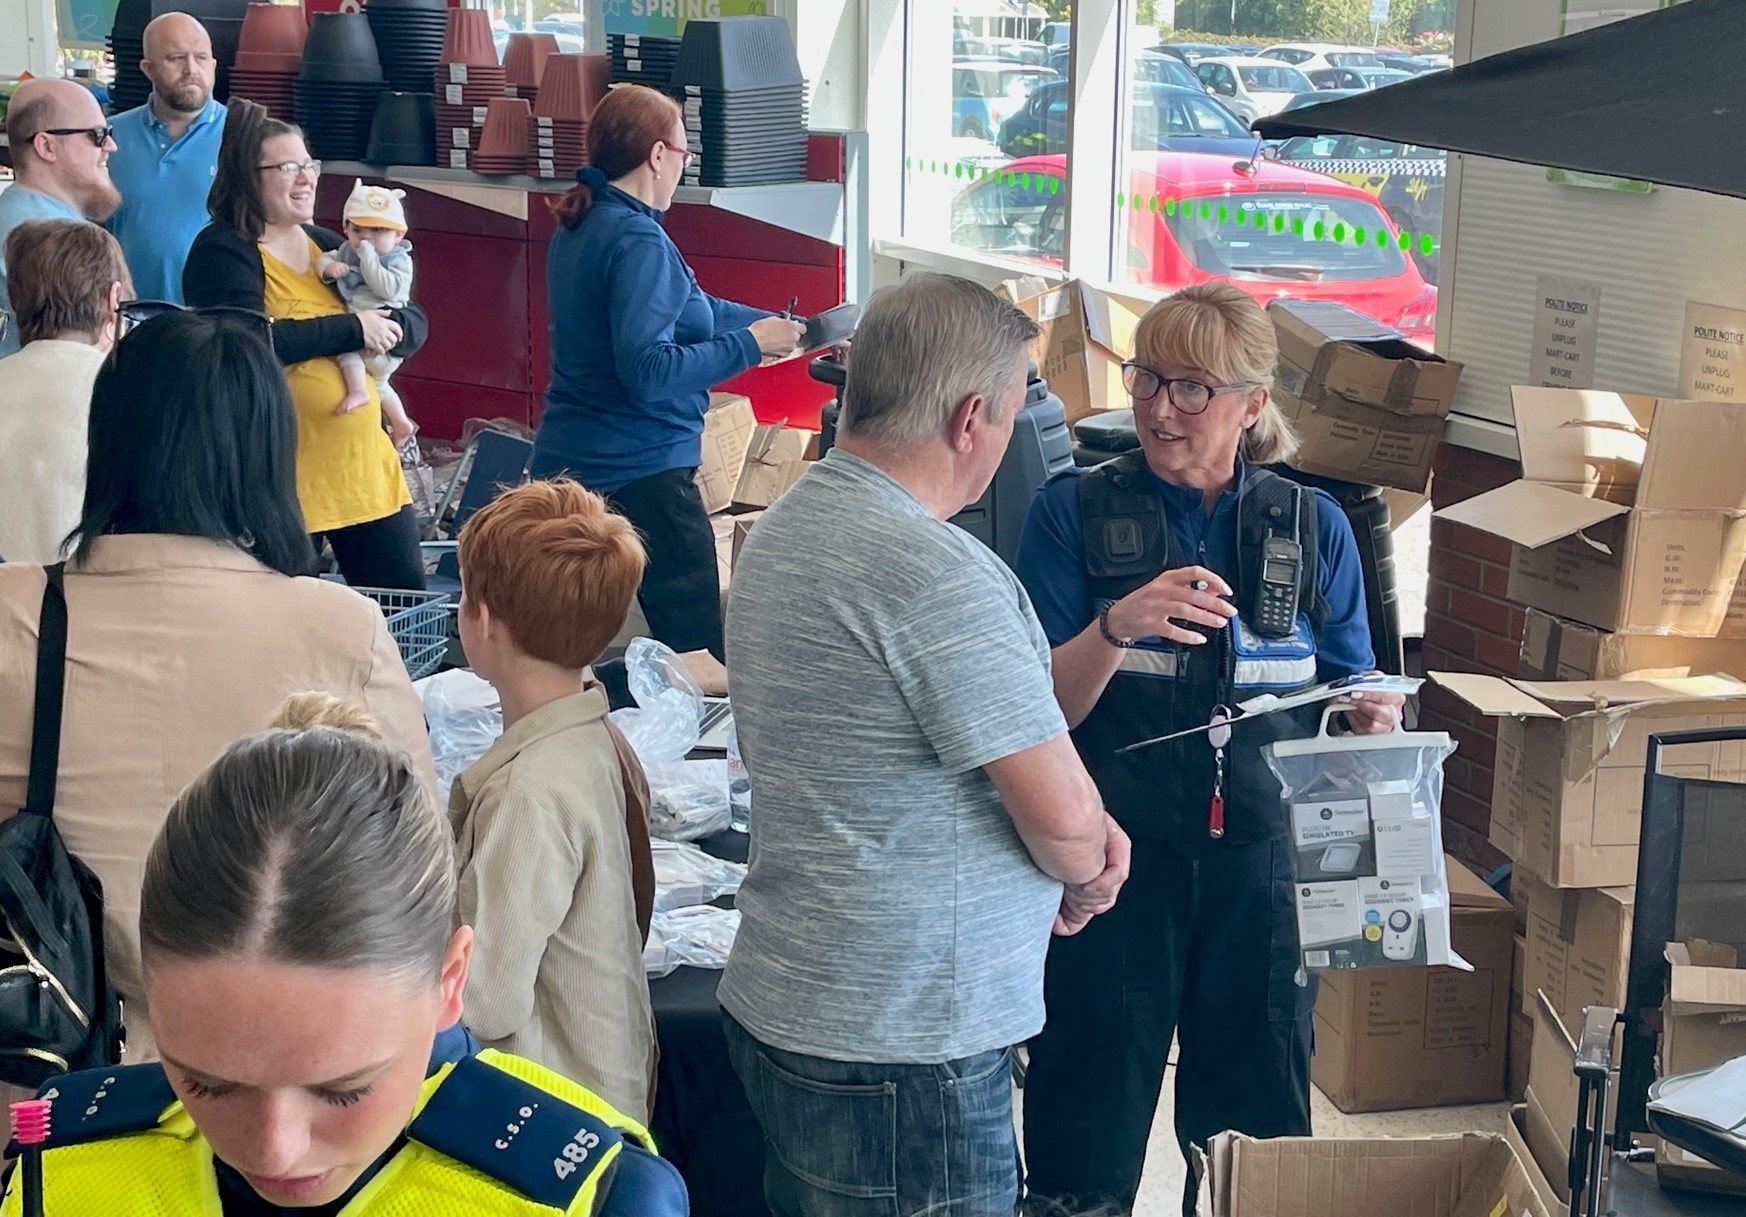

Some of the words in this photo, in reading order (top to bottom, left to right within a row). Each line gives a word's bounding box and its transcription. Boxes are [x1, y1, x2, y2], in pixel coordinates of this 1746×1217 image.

[631, 0, 720, 17] SPRING
[1545, 297, 1565, 309] POLITE
[1566, 301, 1588, 313] NOTICE
[1554, 317, 1576, 329] PLEASE
[1552, 332, 1577, 345] UNPLUG
[1694, 326, 1717, 339] POLITE
[1718, 330, 1744, 344] NOTICE
[1546, 347, 1580, 362] MART-CART
[1705, 347, 1729, 361] PLEASE
[1550, 366, 1573, 379] BEFORE
[1701, 364, 1730, 379] UNPLUG
[1694, 380, 1735, 397] MART-CART
[494, 1103, 539, 1150] C.S.O.
[553, 1128, 600, 1180] 485
